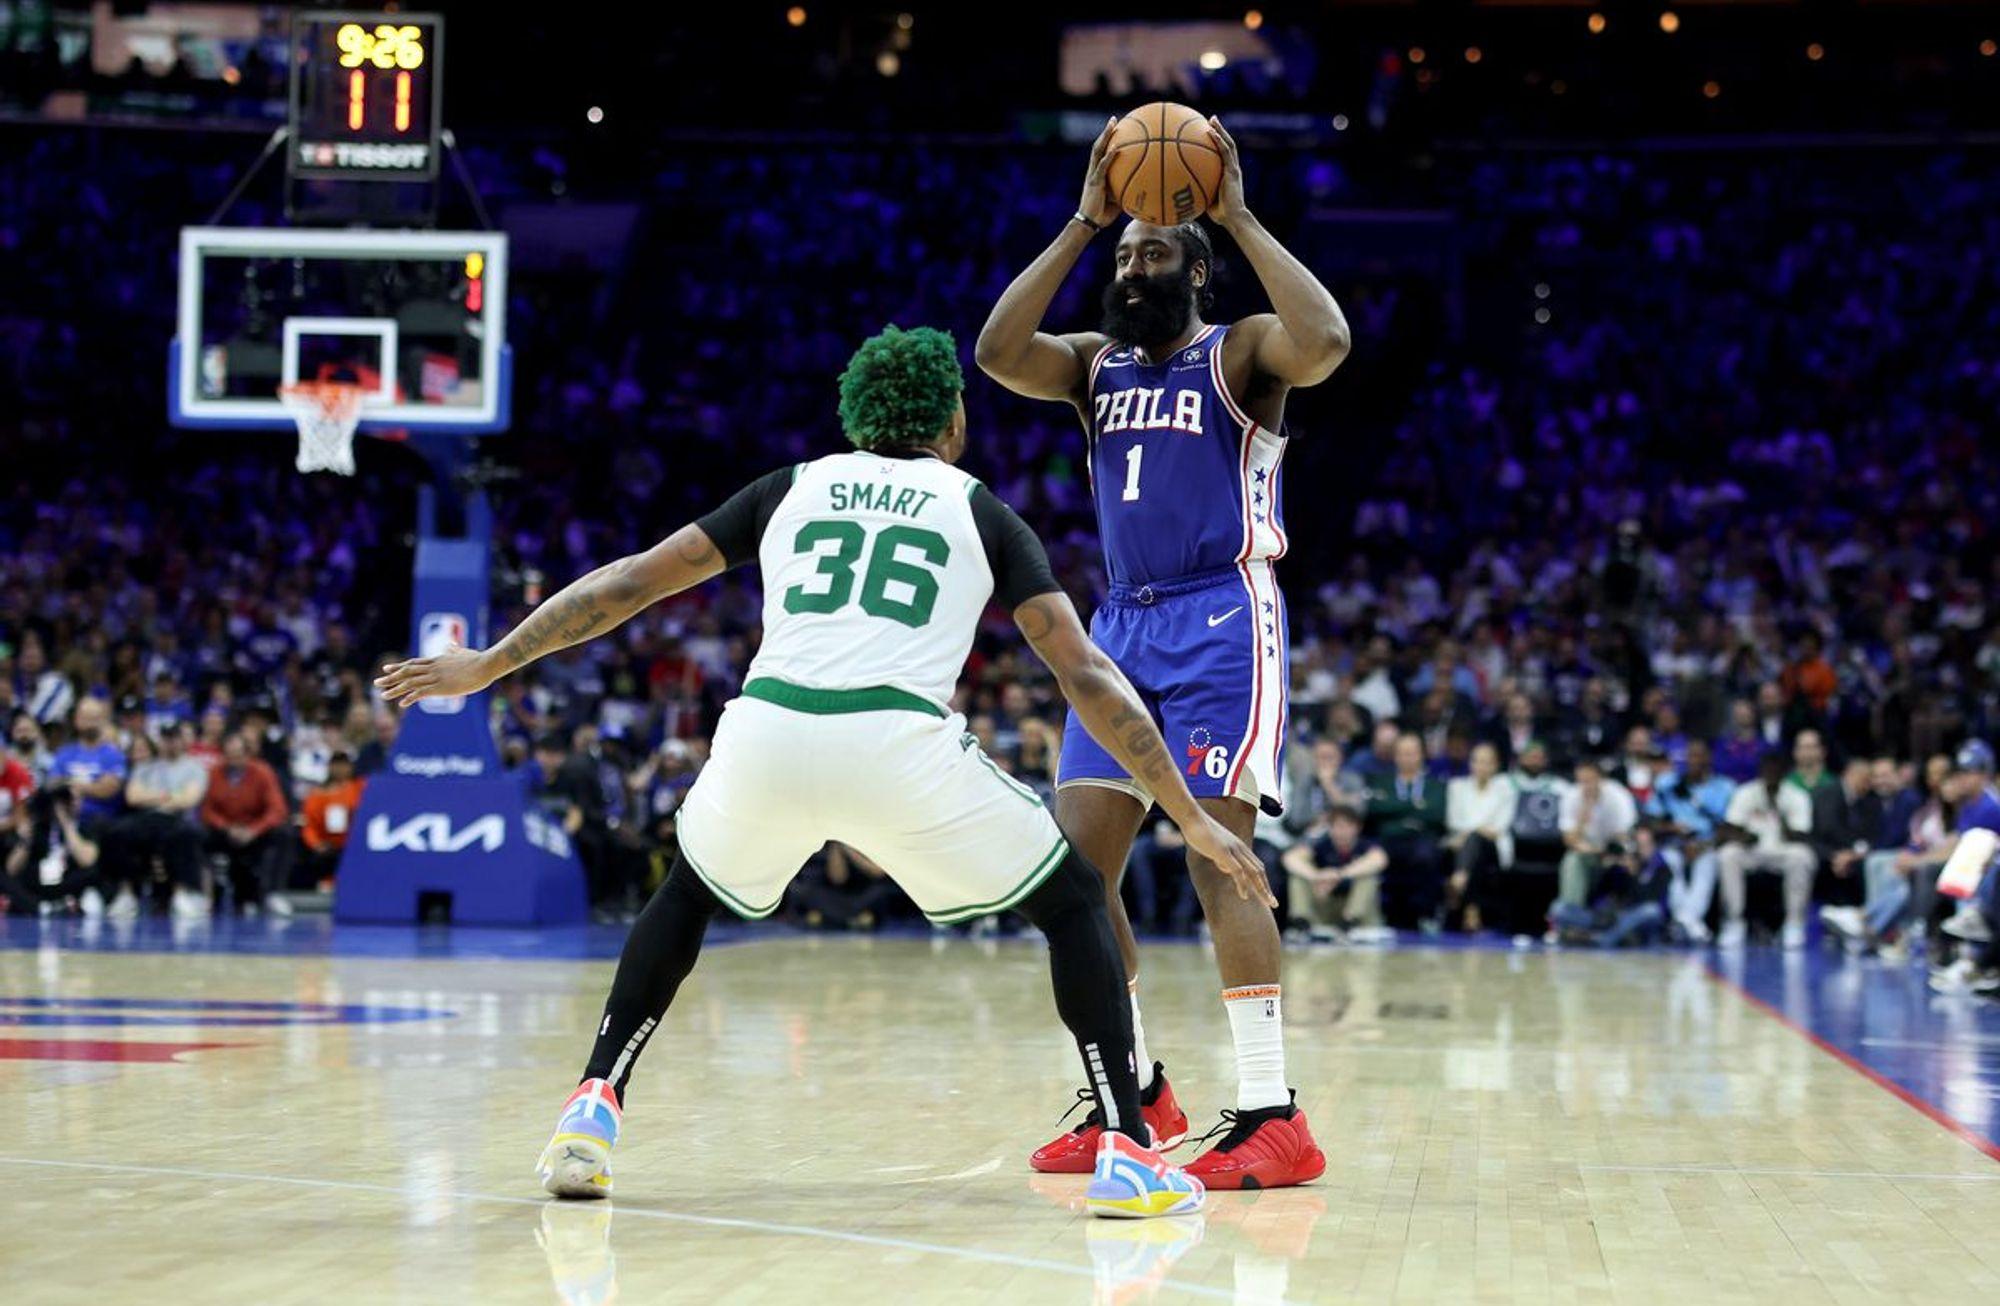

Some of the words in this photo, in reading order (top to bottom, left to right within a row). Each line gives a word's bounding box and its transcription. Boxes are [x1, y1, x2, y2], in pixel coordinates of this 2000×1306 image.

[337, 24, 424, 69] 9:26
[349, 69, 411, 131] 11
[1095, 386, 1204, 435] PHILA
[1122, 444, 1143, 501] 1
[829, 483, 938, 518] SMART
[783, 520, 951, 629] 36
[1187, 744, 1228, 779] 76
